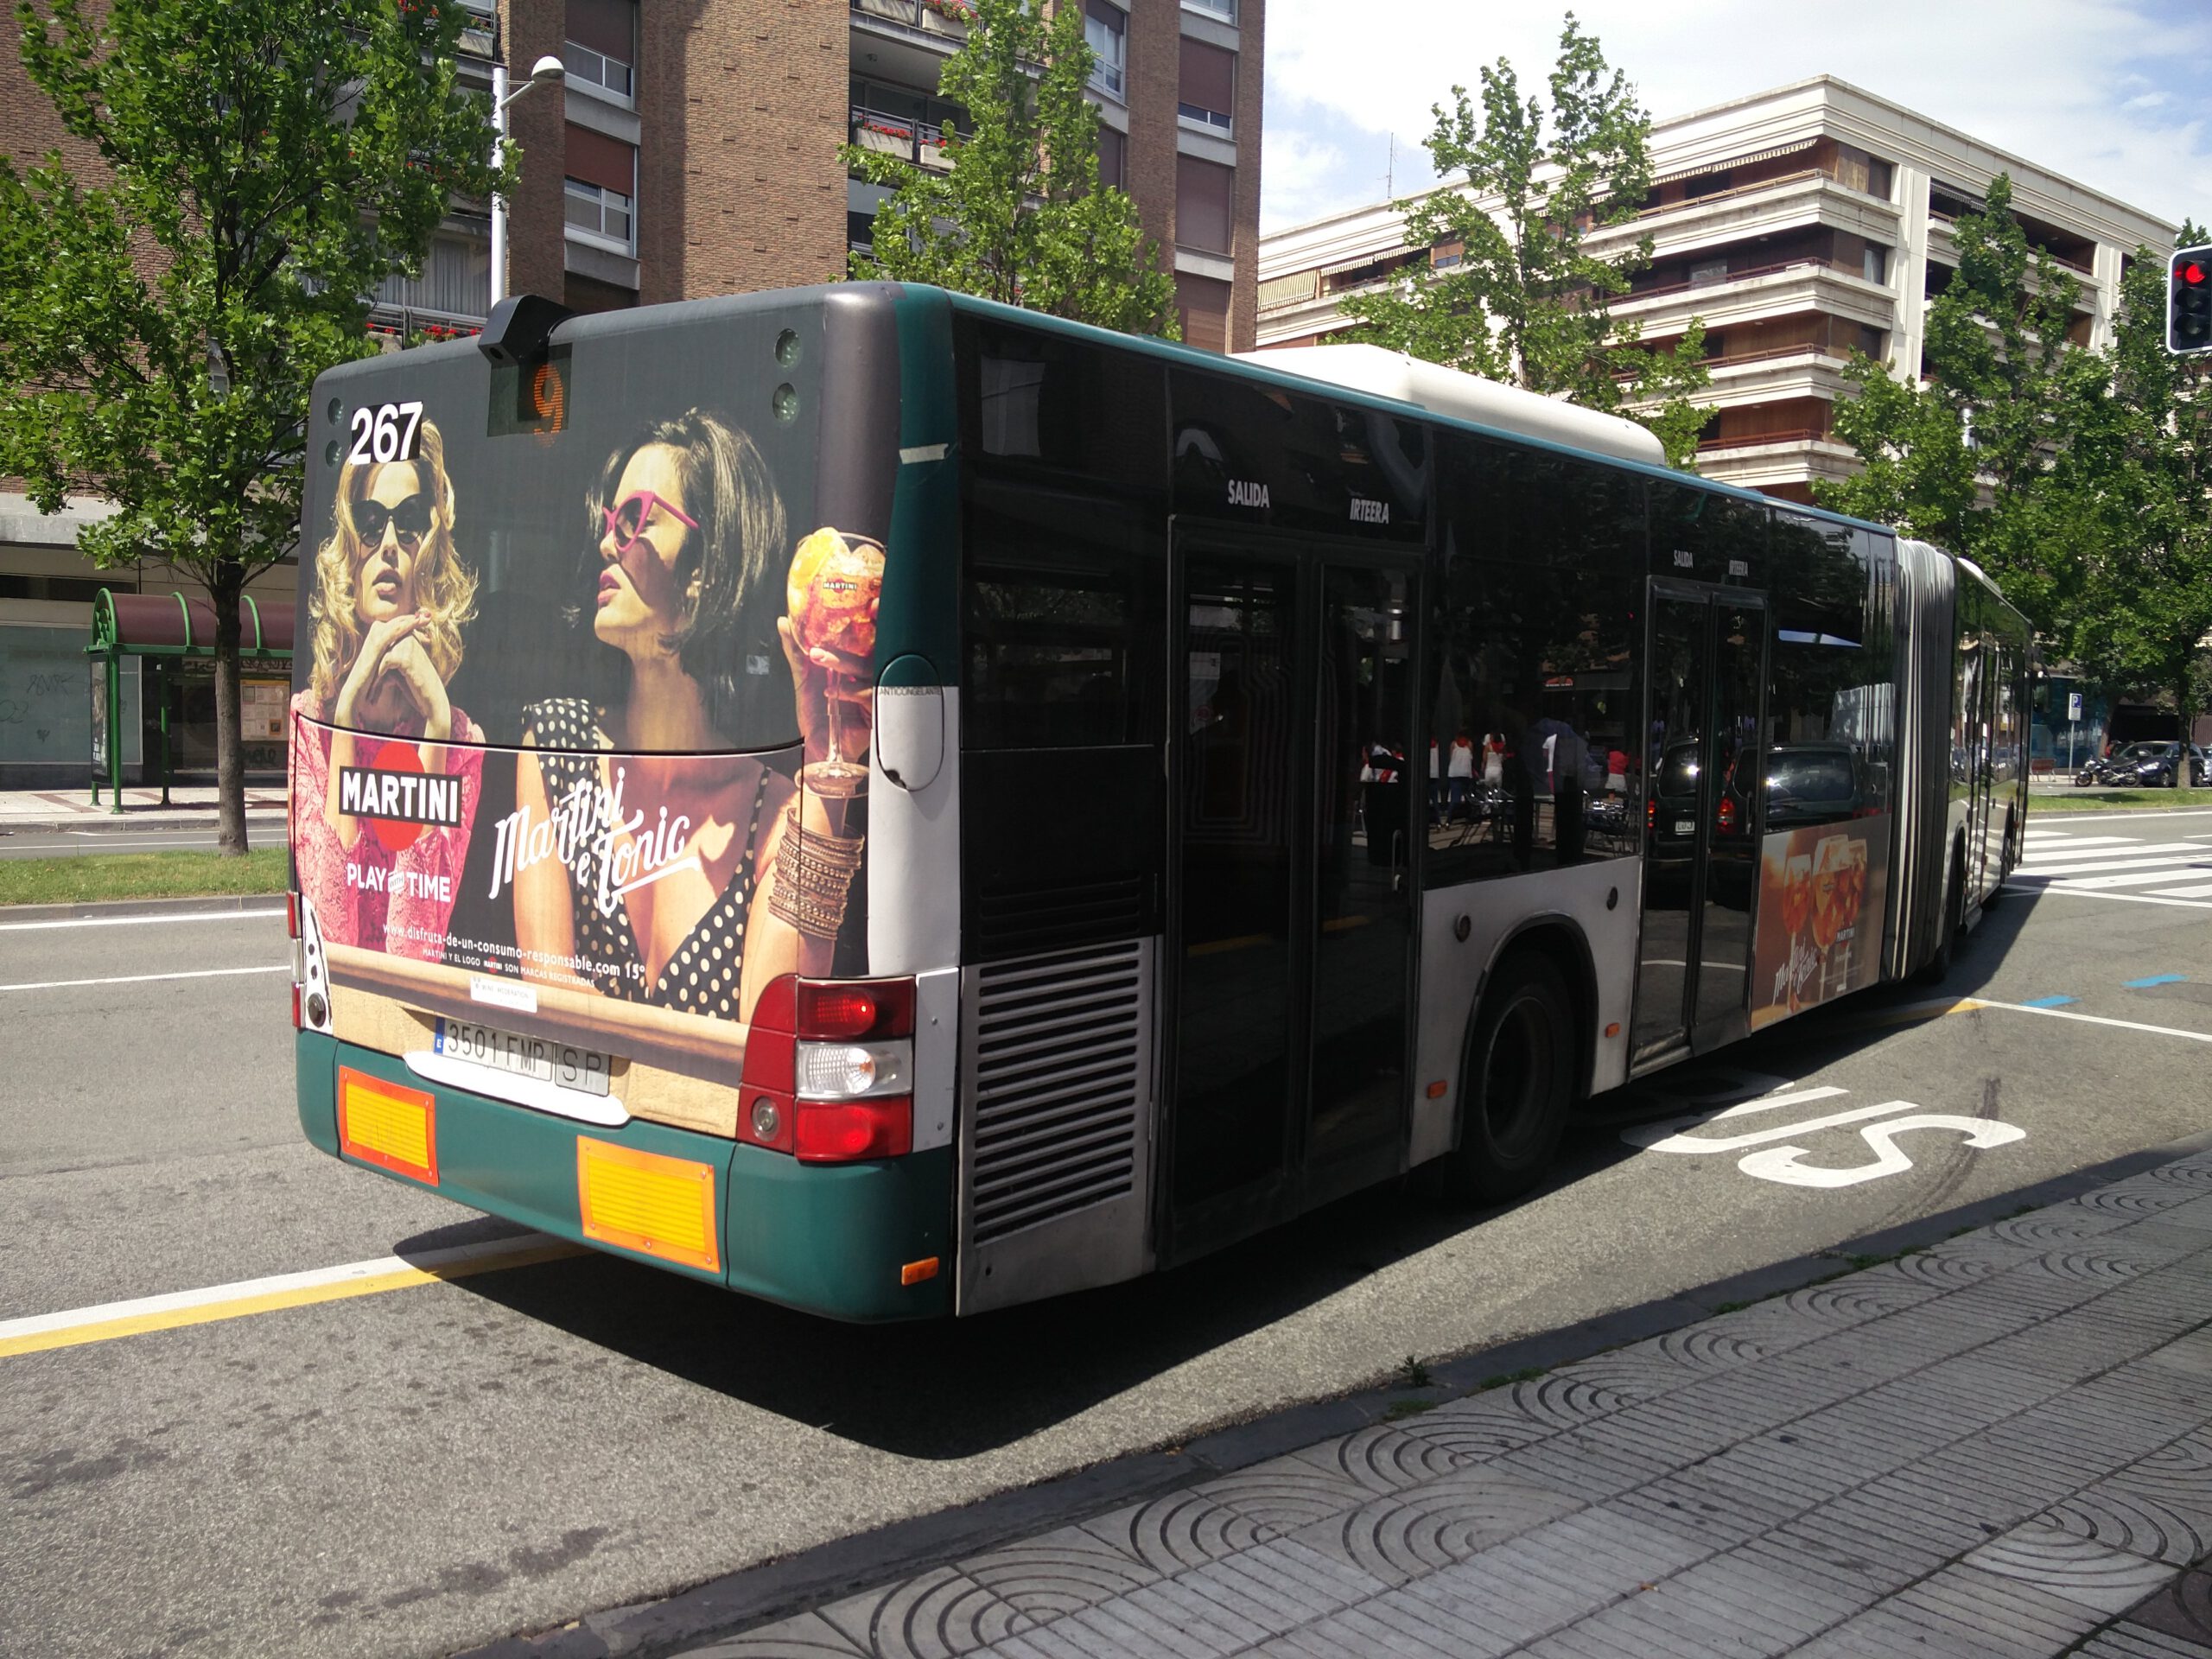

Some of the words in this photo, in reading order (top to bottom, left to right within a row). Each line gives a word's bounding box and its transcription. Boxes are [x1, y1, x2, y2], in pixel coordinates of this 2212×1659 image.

[533, 363, 563, 448] 9
[349, 401, 423, 465] 267
[1228, 479, 1270, 508] SALIDA
[1349, 498, 1389, 524] IRTEERA
[823, 582, 857, 592] MARTINI
[342, 771, 458, 823] MARTINI
[488, 766, 625, 900] Martini
[346, 861, 388, 893] PLAY
[389, 875, 404, 888] WITH
[406, 871, 451, 903] TIME
[591, 805, 702, 919] Tonic
[382, 923, 620, 977] www.disfruta-de-un-consumo-responsable.com
[423, 948, 448, 961] MARTINI
[454, 954, 461, 963] EL
[462, 956, 481, 967] LOGO
[505, 963, 519, 974] SON
[520, 966, 548, 979] MARCAS
[549, 973, 595, 988] REGISTRADAS
[436, 1039, 442, 1048] E
[448, 1023, 497, 1064] 3501
[506, 1036, 545, 1073] FMP
